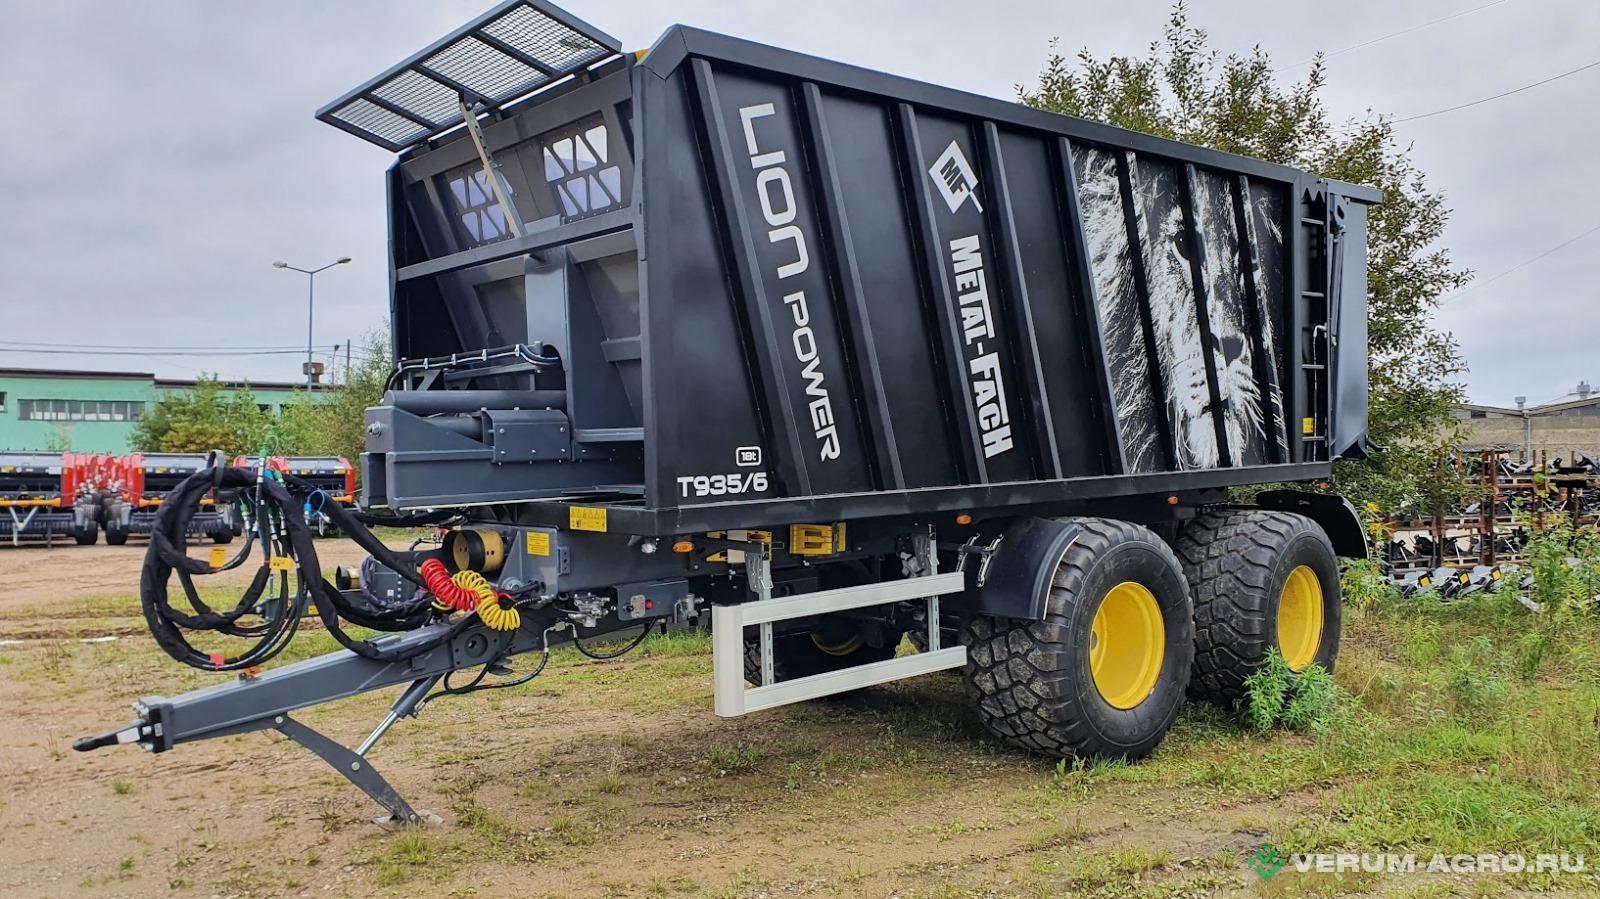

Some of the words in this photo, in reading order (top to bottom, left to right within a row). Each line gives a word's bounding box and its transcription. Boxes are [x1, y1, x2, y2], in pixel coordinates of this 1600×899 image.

[940, 156, 970, 194] MF
[783, 291, 840, 461] POWER
[950, 234, 1014, 459] METAL-FACH
[677, 472, 768, 497] T935/6
